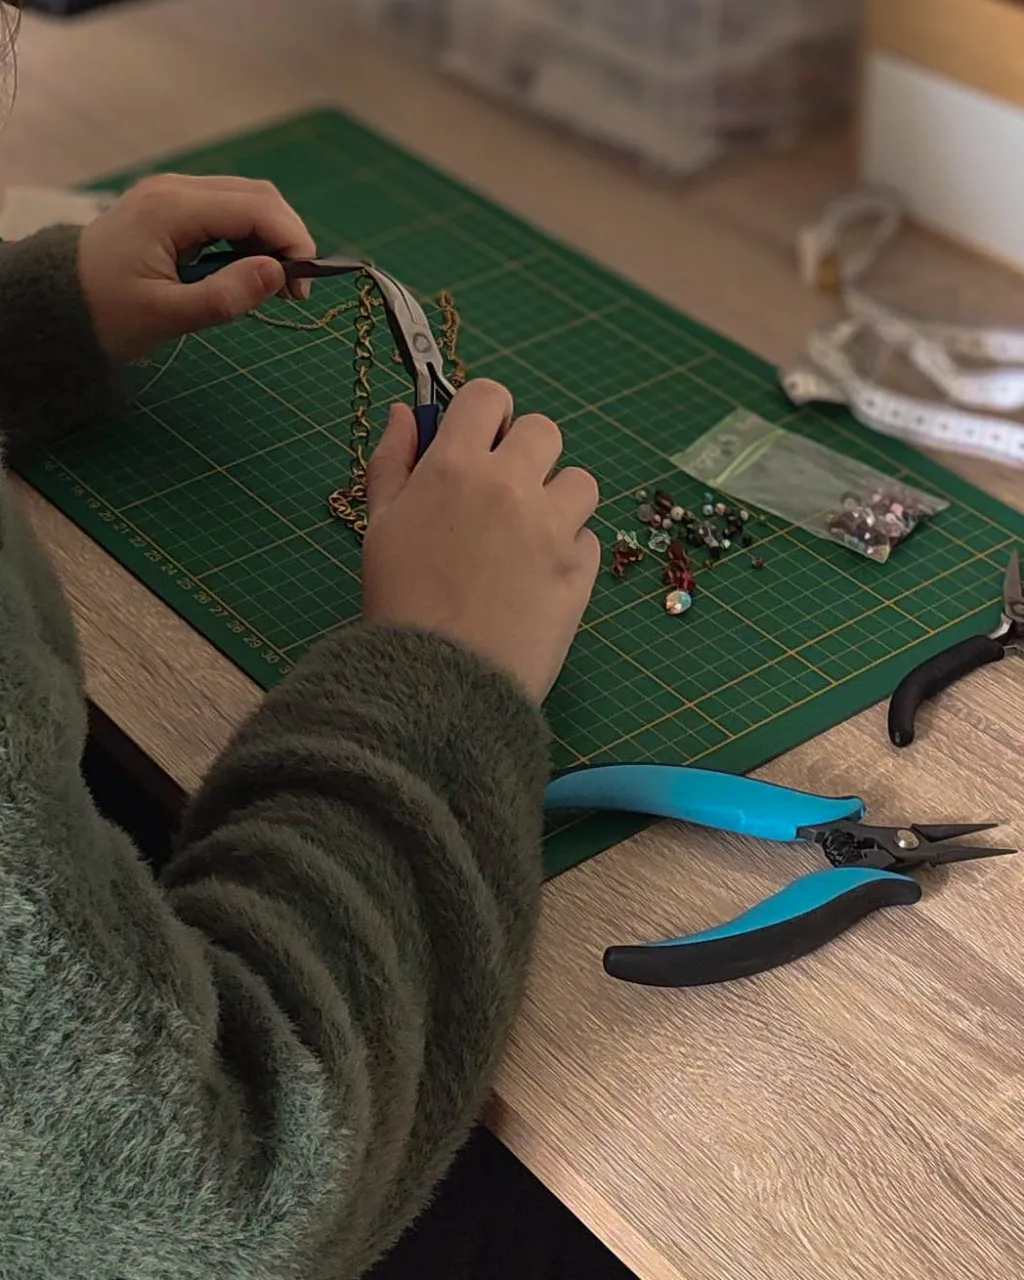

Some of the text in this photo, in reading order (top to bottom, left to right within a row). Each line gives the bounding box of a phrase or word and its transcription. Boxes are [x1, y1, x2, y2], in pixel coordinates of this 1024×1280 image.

[98, 509, 117, 522] 20
[112, 522, 130, 534] 21
[128, 535, 148, 548] 22
[143, 549, 163, 563] 23
[160, 562, 178, 575] 24
[176, 577, 195, 590] 25
[192, 590, 212, 604] 26
[208, 605, 229, 618] 27
[226, 619, 246, 634] 28
[242, 633, 264, 649] 29
[260, 649, 281, 664] 30
